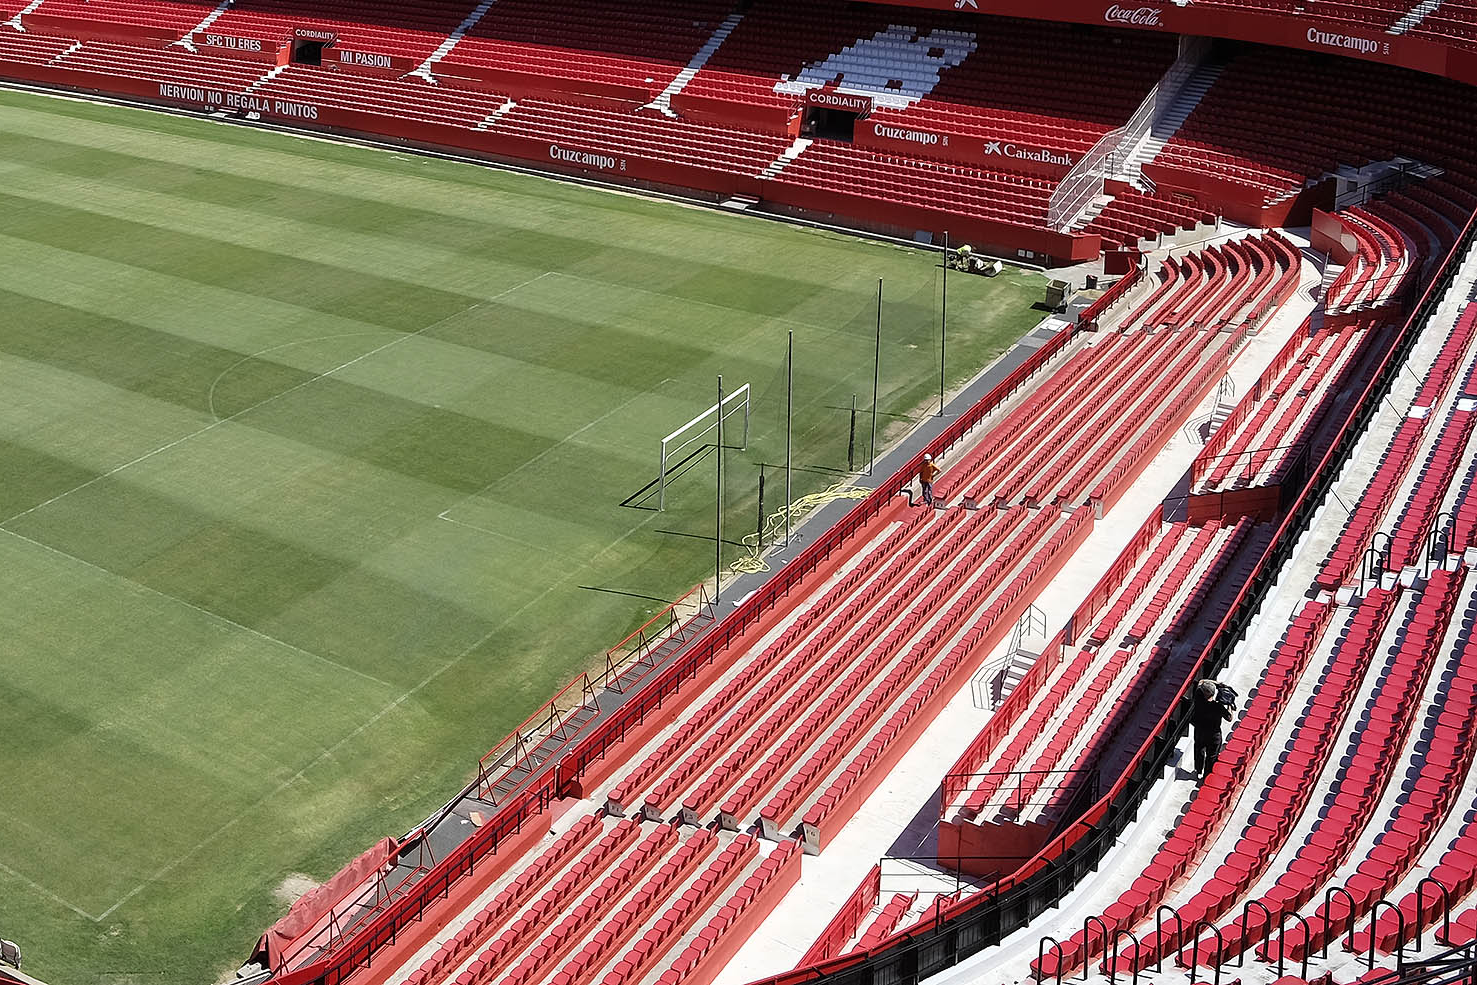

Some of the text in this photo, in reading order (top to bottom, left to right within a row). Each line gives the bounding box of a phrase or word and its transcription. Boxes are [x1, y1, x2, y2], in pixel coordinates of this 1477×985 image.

[205, 34, 261, 51] SFC TU ERES
[295, 28, 335, 40] CORDIALITY
[1306, 27, 1379, 54] Cruzcampo
[340, 50, 391, 68] MI PASION
[159, 83, 318, 120] NERVION NO REGALA PUNTOS
[809, 91, 867, 110] CORDIALITY
[873, 123, 938, 145] Cruzcampo
[549, 144, 615, 170] Cruzcampo
[1003, 144, 1074, 167] CaixaBank
